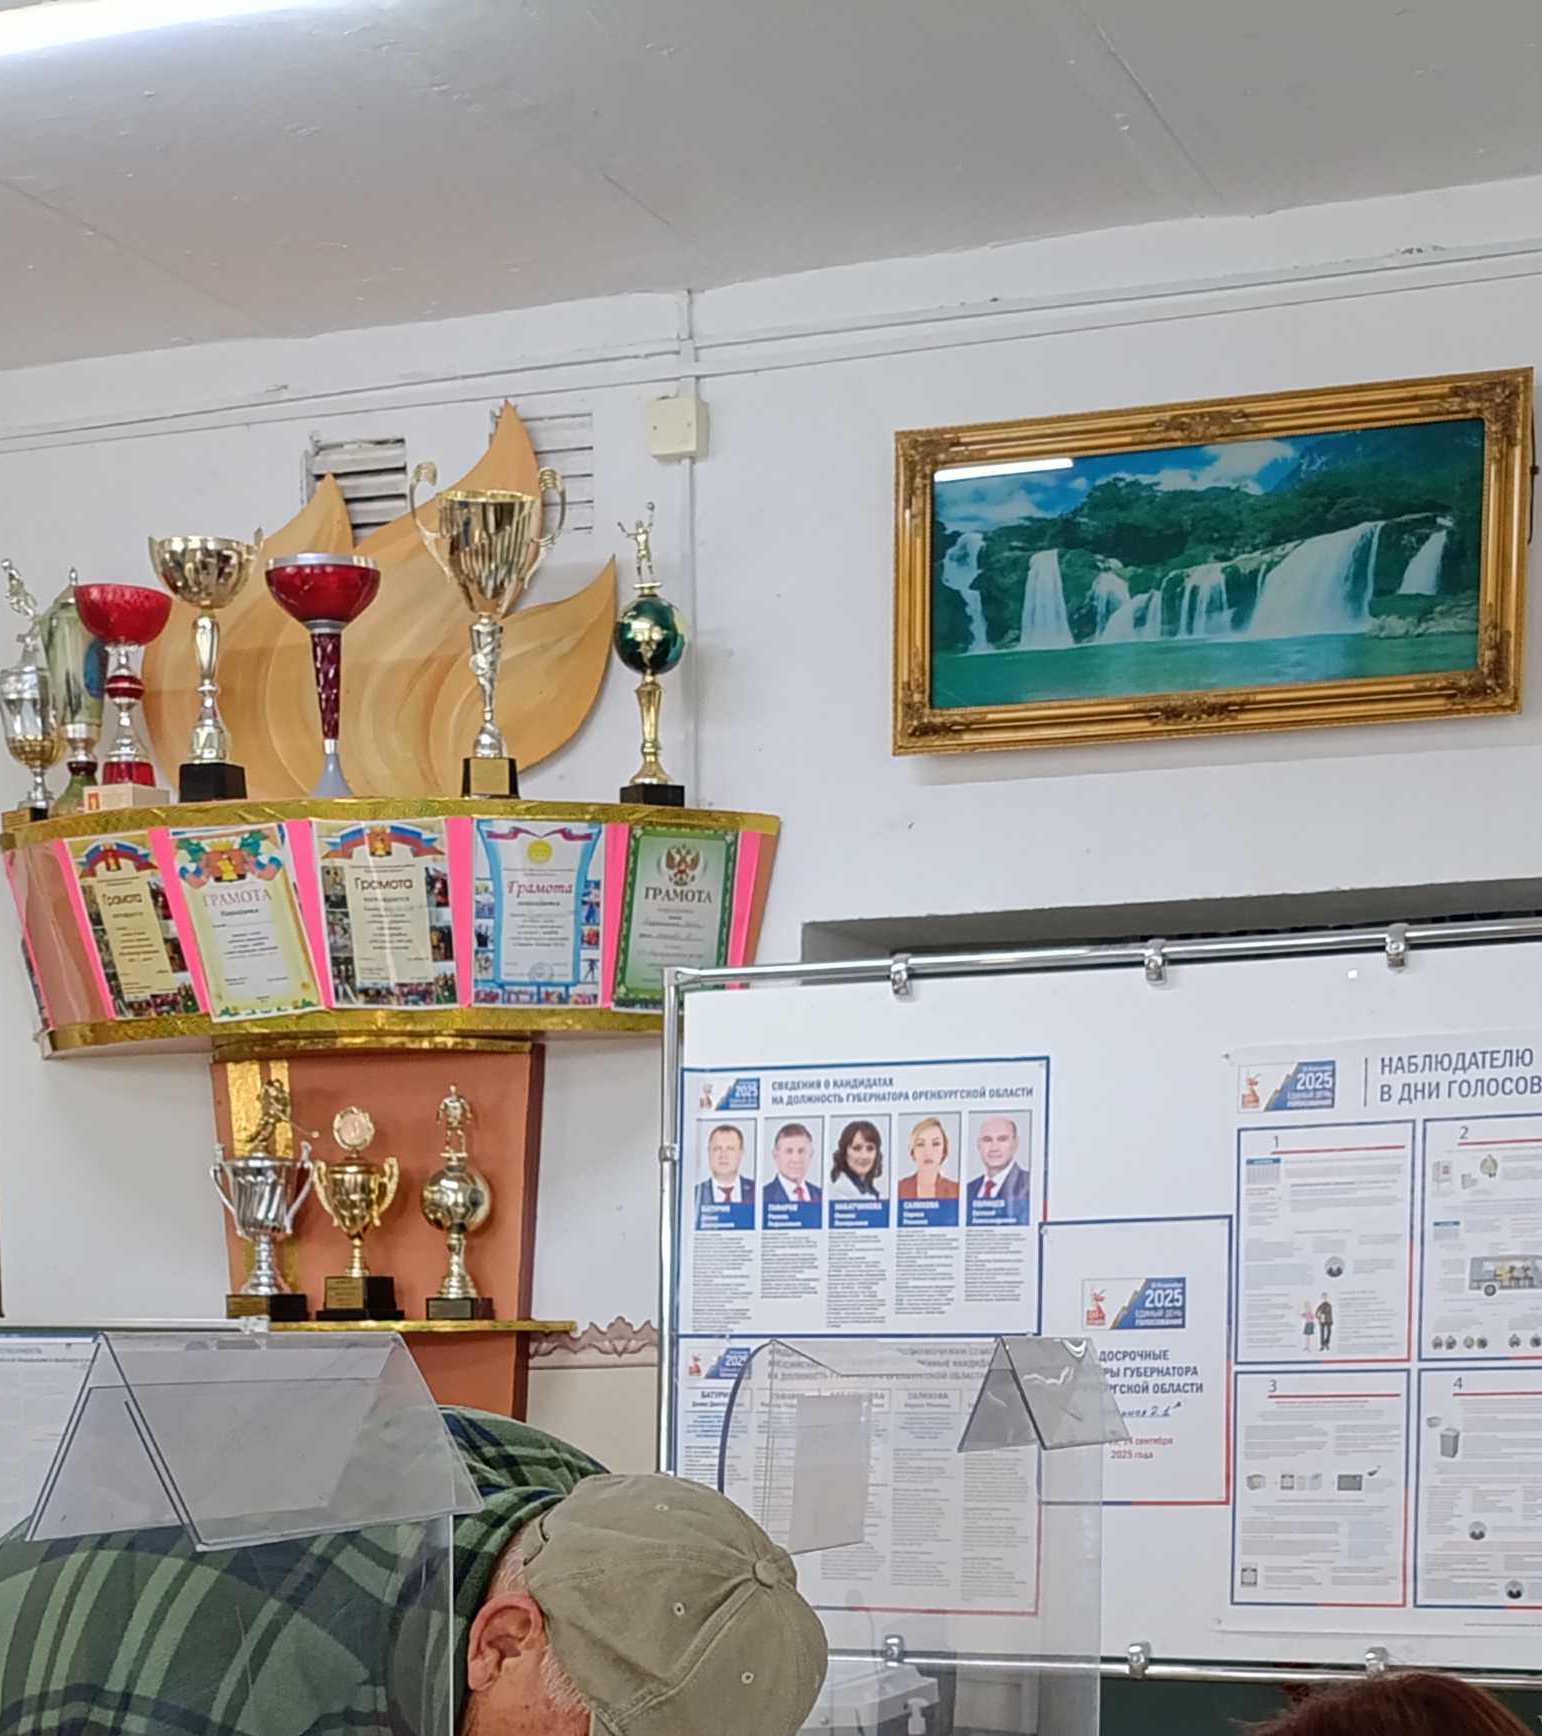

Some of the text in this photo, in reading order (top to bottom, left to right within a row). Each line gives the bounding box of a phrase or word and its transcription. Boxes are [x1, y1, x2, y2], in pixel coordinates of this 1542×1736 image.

[355, 878, 413, 891] Грамота
[508, 881, 573, 898] Грамота
[102, 893, 142, 907] Грамота
[203, 889, 272, 908] ГРАМОТА
[645, 887, 713, 903] ГРАМОТА
[1380, 1048, 1534, 1075] НАБЛЮДАТЕЛЮ
[771, 1077, 894, 1091] СВЕДЕНИЯ О КАНДИДАТАХ
[1296, 1072, 1333, 1090] 2025
[735, 1084, 759, 1098] 2025
[771, 1087, 1033, 1106] НА ДОЛЖНОСТЬ ГУБЕРНАТОРА ОРЕНБУРГСКОЙ ОБЛАСТИ
[1380, 1085, 1392, 1102] В
[1398, 1082, 1440, 1104] ДНИ
[1459, 1126, 1469, 1139] 2
[1272, 1135, 1279, 1149] 1
[1145, 1289, 1183, 1308] 2025
[1099, 1350, 1170, 1362] ДОСРОЧНЫЕ
[1123, 1366, 1198, 1378] ГУБЕРНАТОРА
[1153, 1383, 1203, 1394] ОБЛАСТИ
[1268, 1379, 1277, 1393] 3
[1454, 1377, 1463, 1389] 4
[1135, 1437, 1173, 1446] сентября
[1111, 1451, 1153, 1460] 2025 года
